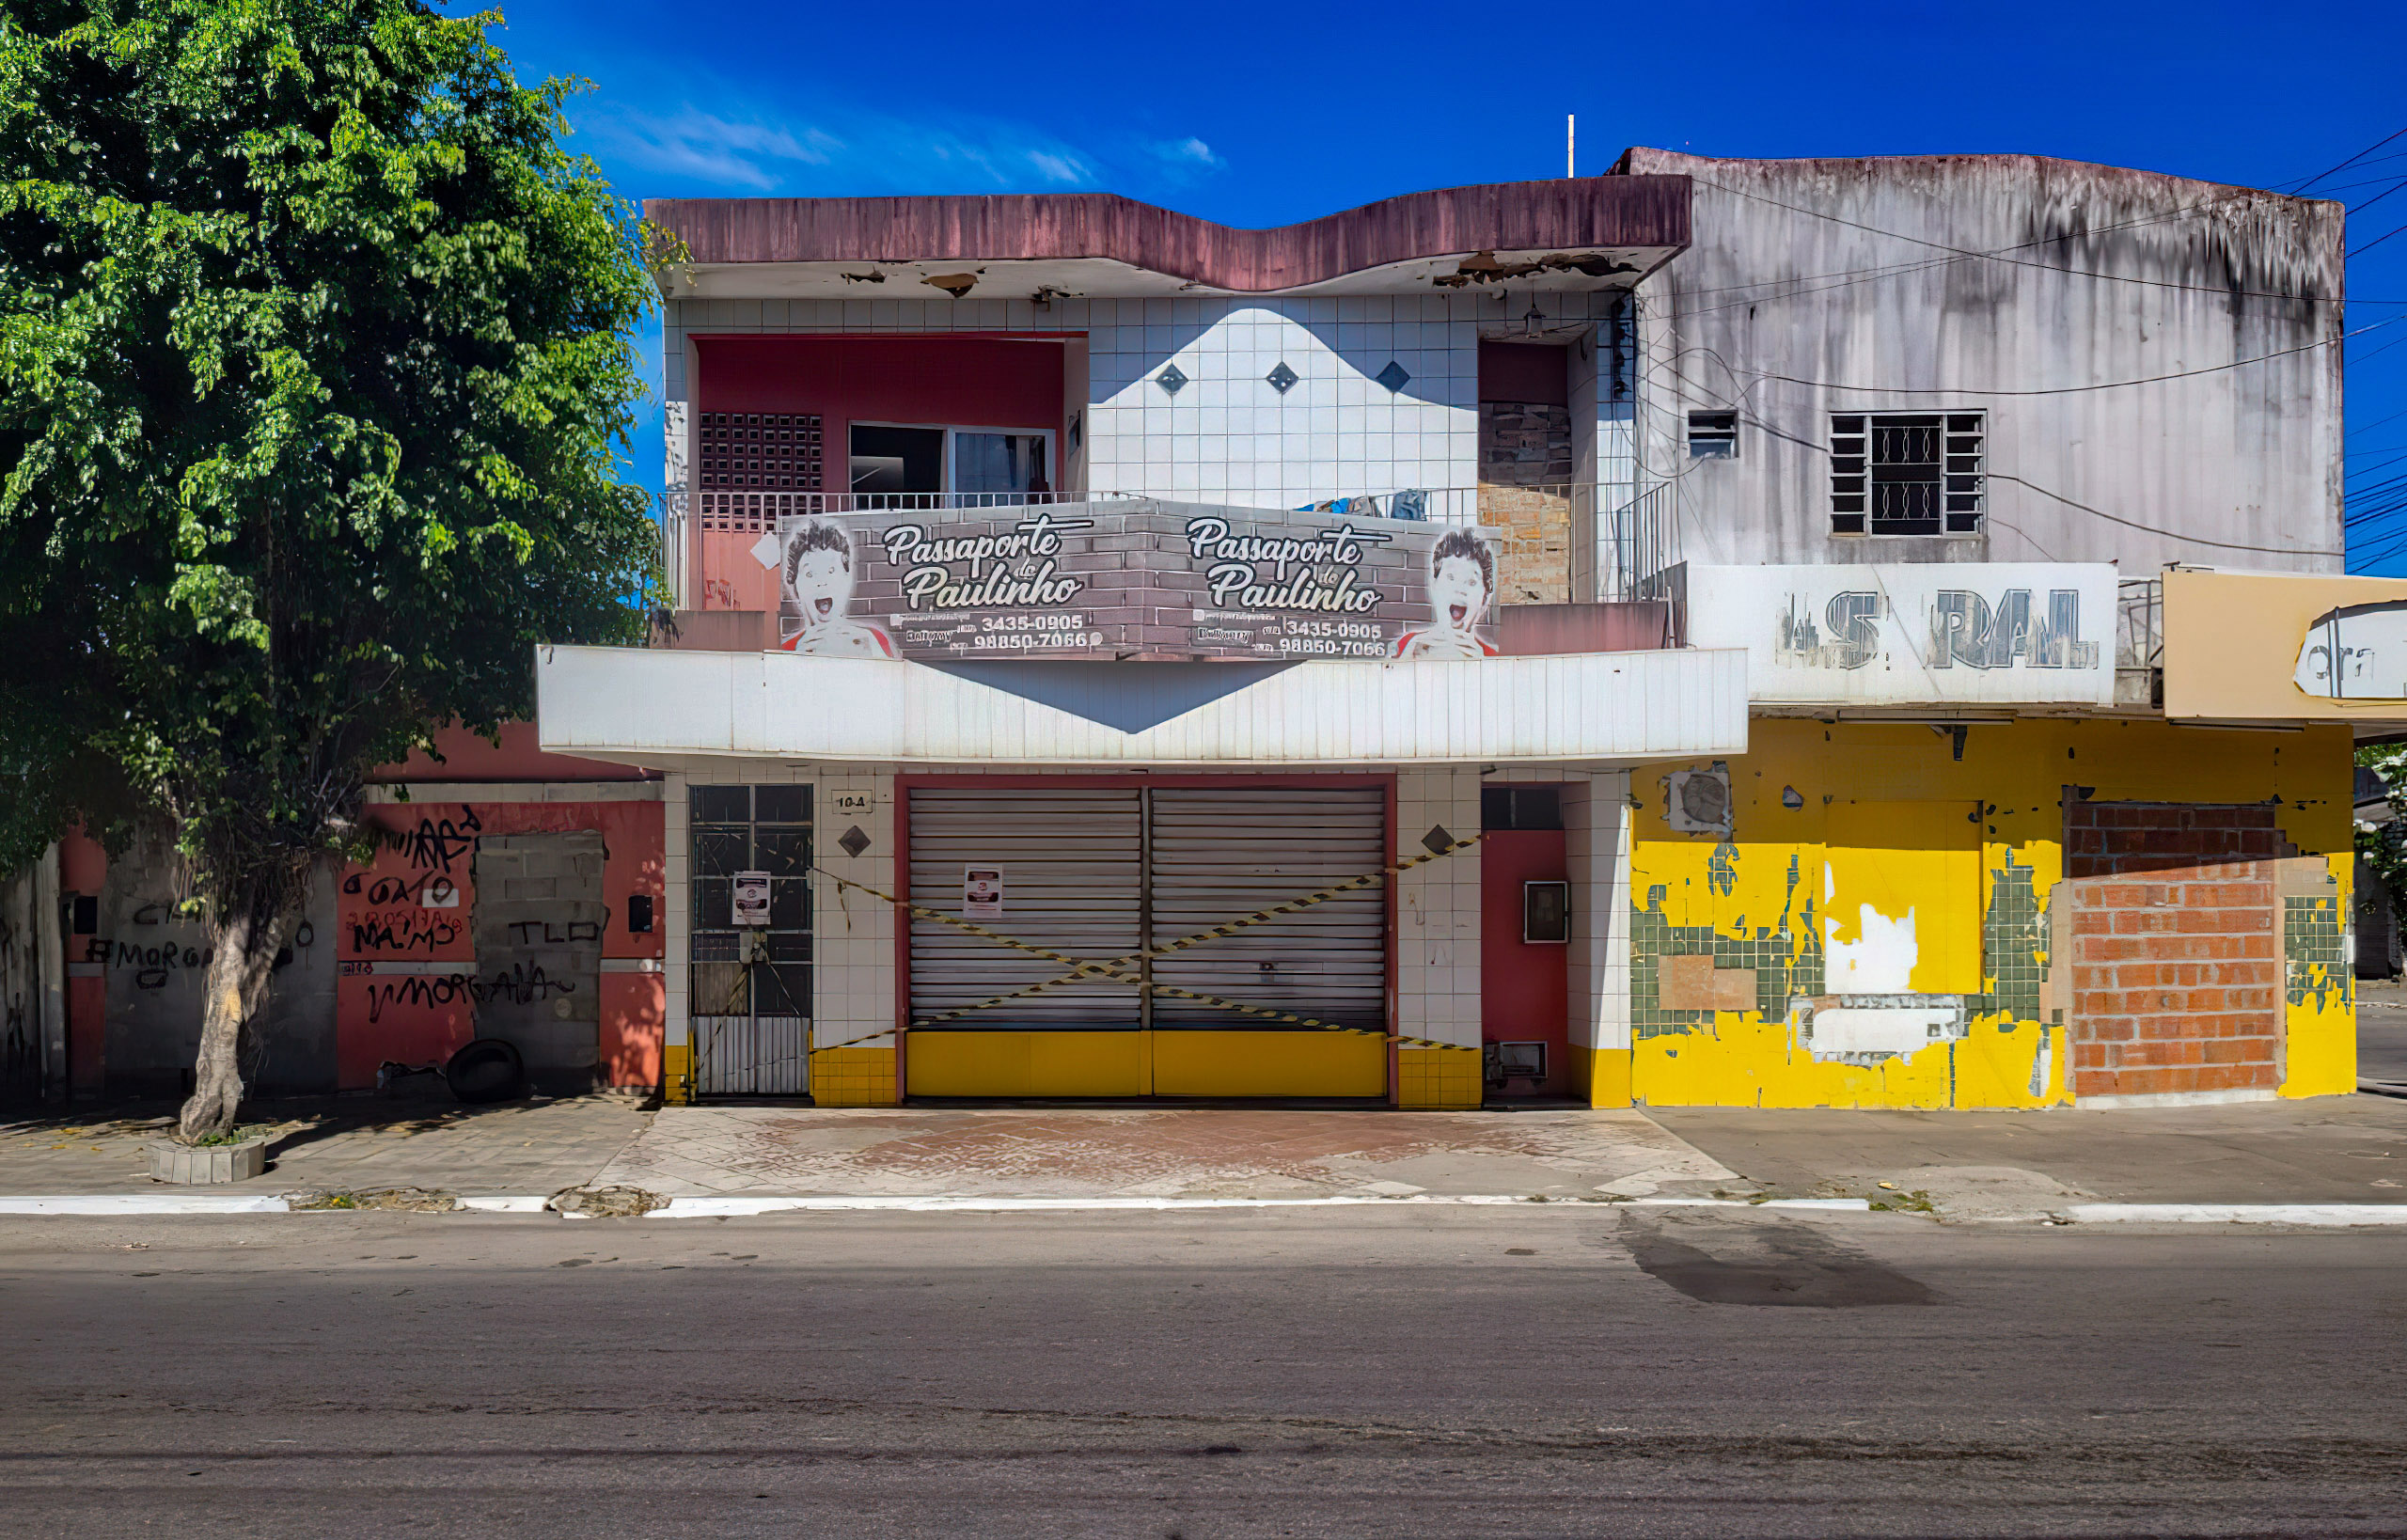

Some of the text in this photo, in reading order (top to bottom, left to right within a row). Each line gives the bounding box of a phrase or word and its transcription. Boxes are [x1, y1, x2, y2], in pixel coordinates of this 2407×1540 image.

[885, 513, 1094, 577] Passaporte
[1187, 517, 1392, 581] Passaporte
[904, 560, 1084, 609] Paulinho
[1207, 566, 1383, 613] Paulinho
[982, 616, 1083, 632] 3435-0905
[1286, 621, 1381, 639] 3435-0905
